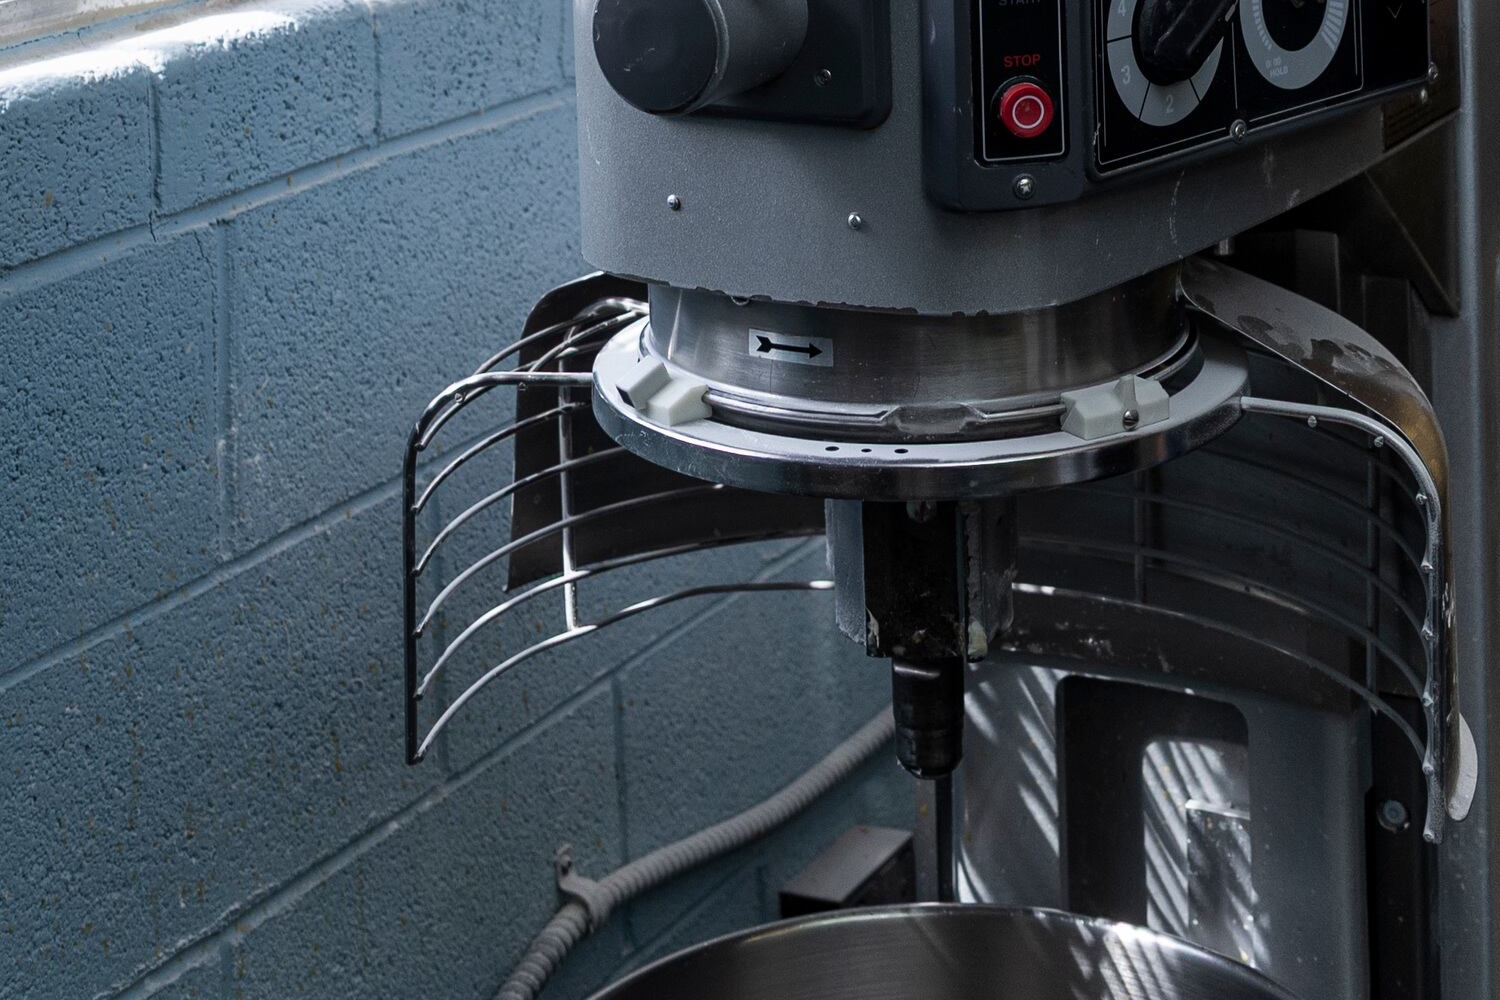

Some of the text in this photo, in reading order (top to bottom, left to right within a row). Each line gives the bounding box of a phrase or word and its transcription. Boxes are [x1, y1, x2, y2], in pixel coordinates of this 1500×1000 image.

[1117, 0, 1126, 17] 4
[1003, 54, 1041, 68] STOP
[1121, 65, 1131, 85] 3
[1165, 95, 1174, 114] 2
